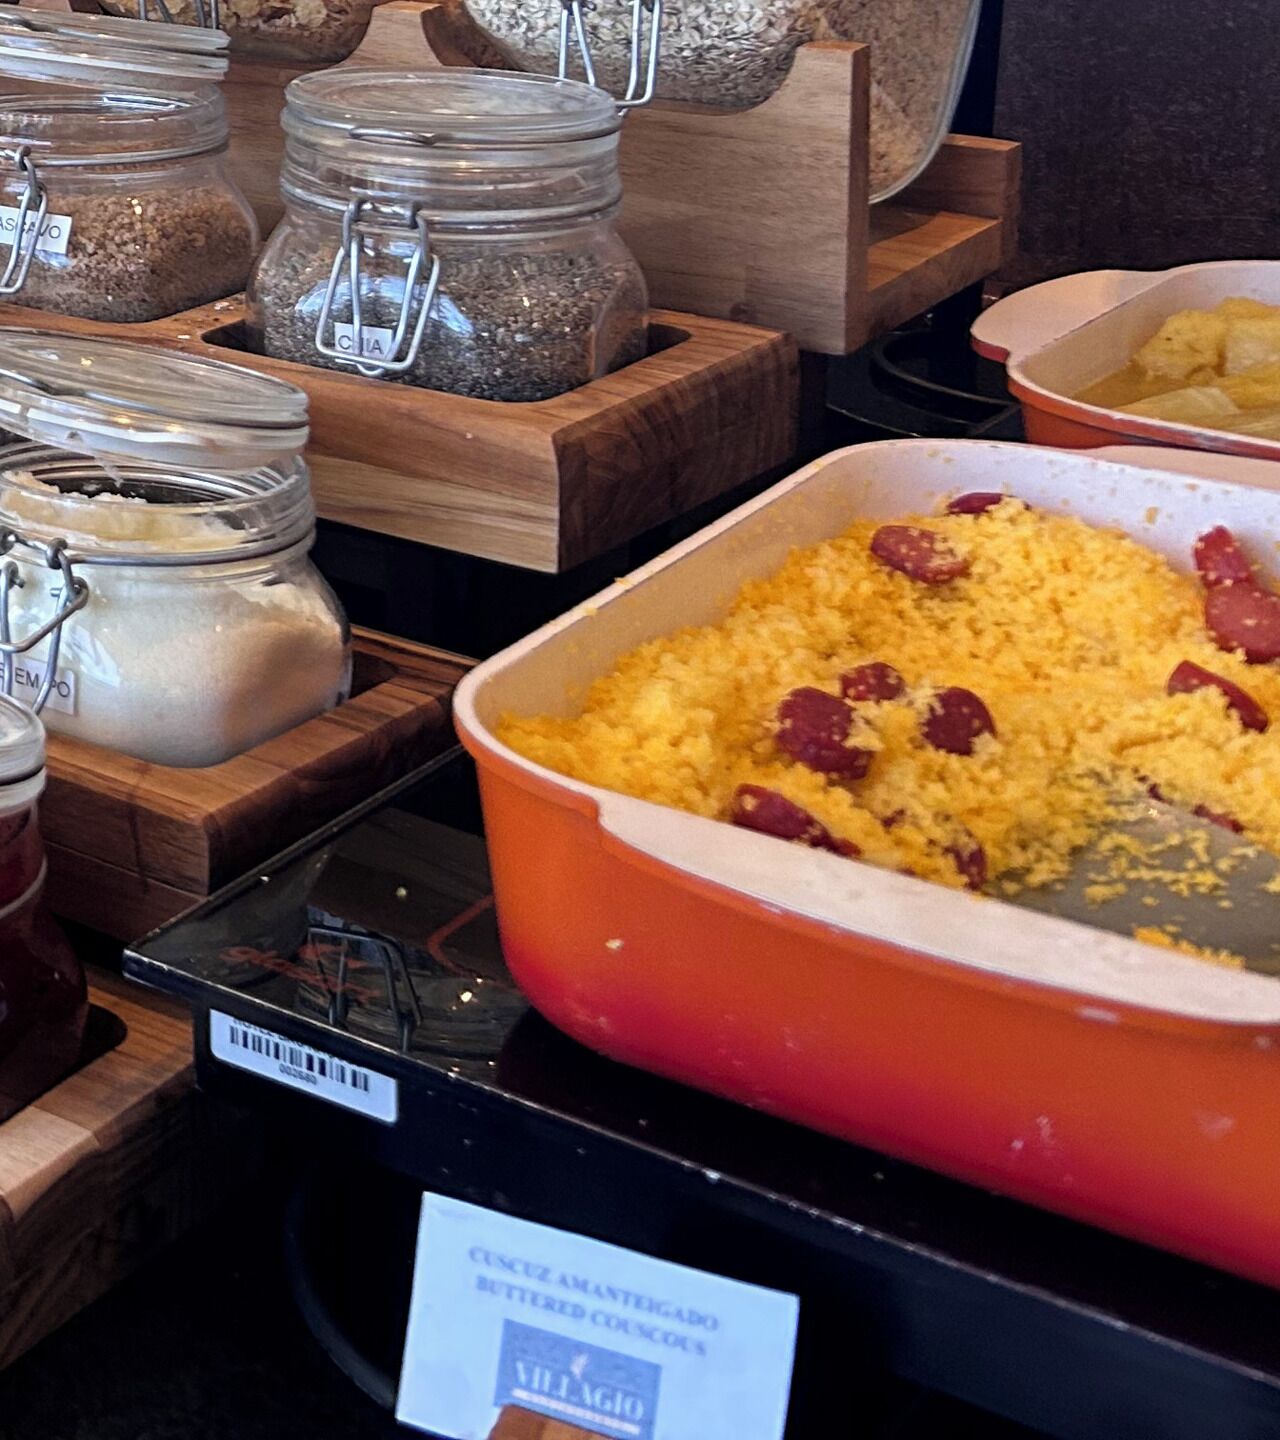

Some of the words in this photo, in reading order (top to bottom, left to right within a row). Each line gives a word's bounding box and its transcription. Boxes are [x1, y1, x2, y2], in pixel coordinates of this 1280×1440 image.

[15, 666, 40, 689] EM
[468, 1245, 550, 1282] CUSCUZ
[556, 1270, 719, 1331] AMANTEIGADO
[475, 1274, 586, 1321] BUTTERED
[590, 1309, 707, 1357] COUSCOUS
[515, 1360, 644, 1421] VILLAGIO
